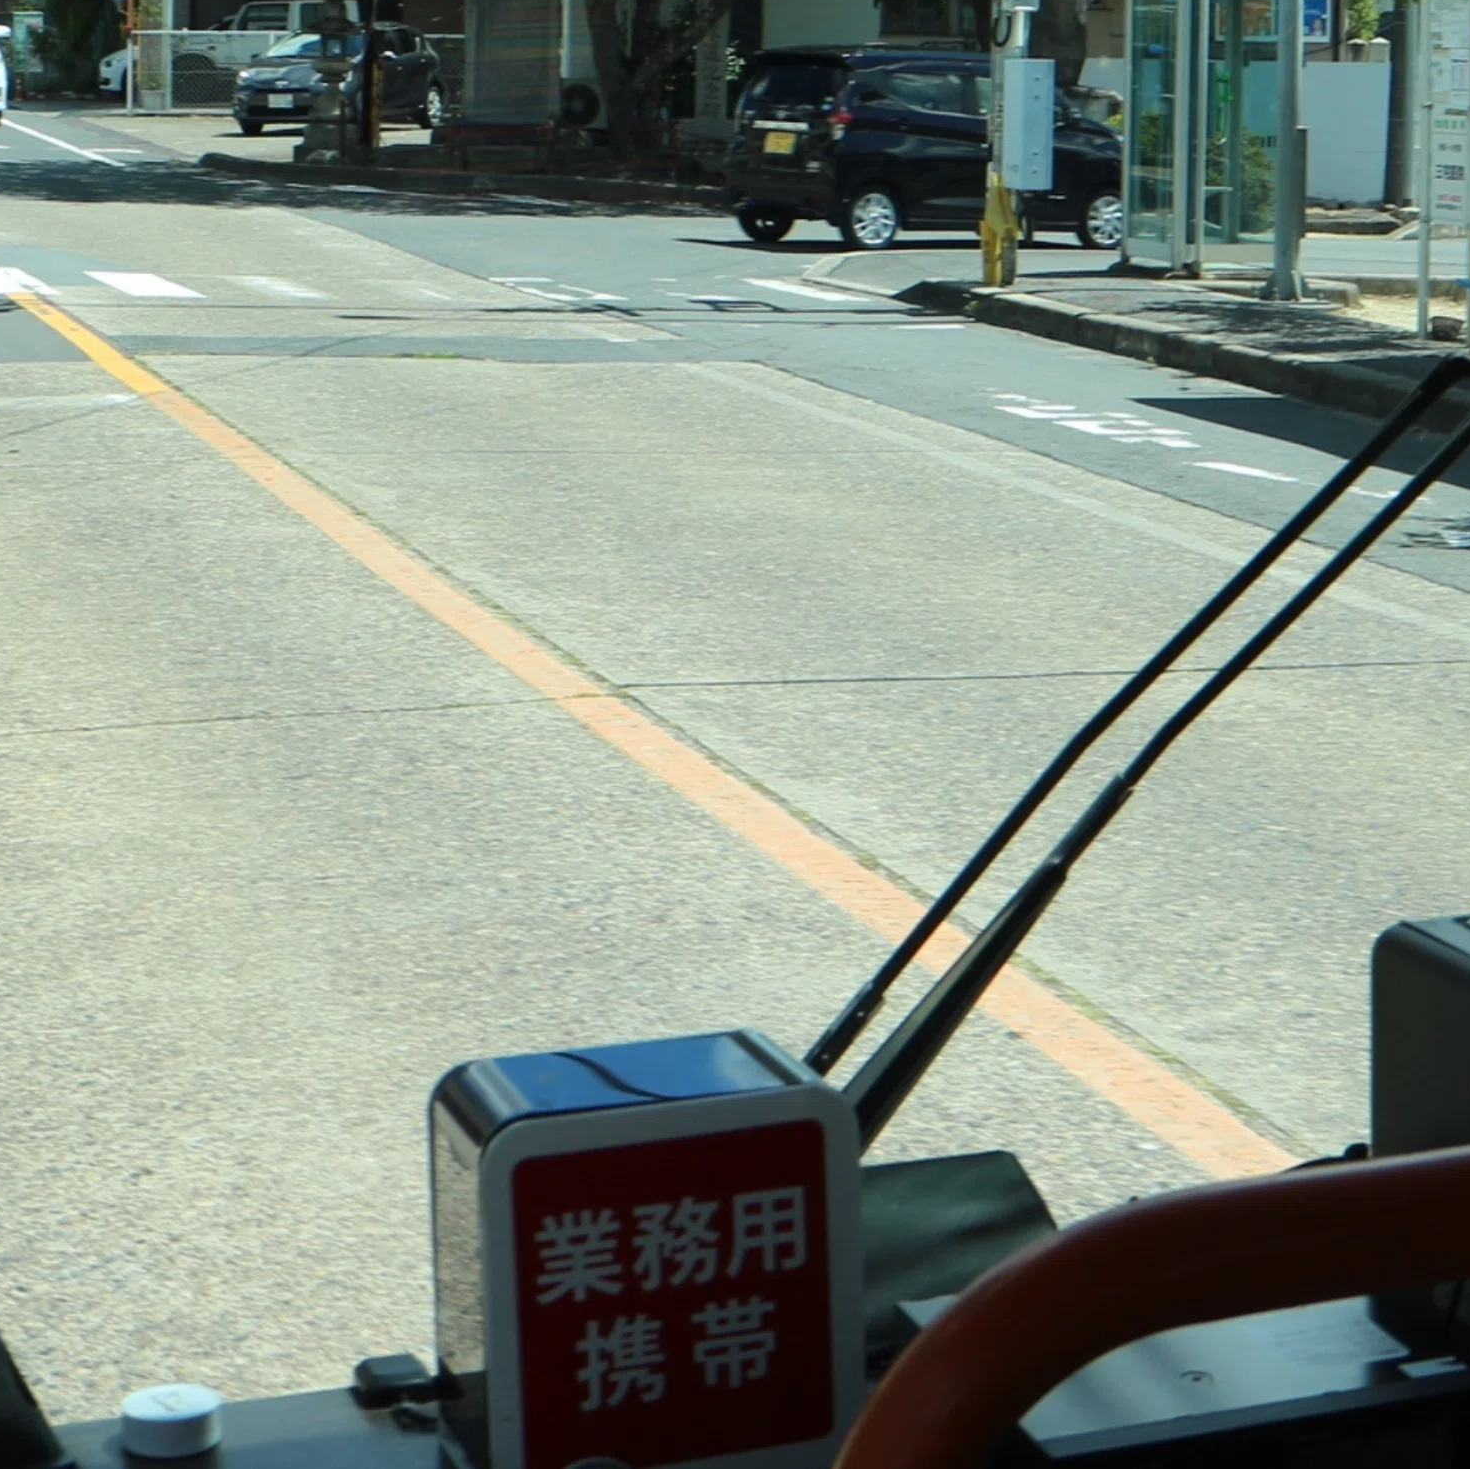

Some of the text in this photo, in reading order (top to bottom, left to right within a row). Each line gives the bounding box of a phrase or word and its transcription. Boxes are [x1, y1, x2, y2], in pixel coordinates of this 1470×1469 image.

[534, 1185, 808, 1306] 業務用
[574, 1295, 777, 1412] 携帯
